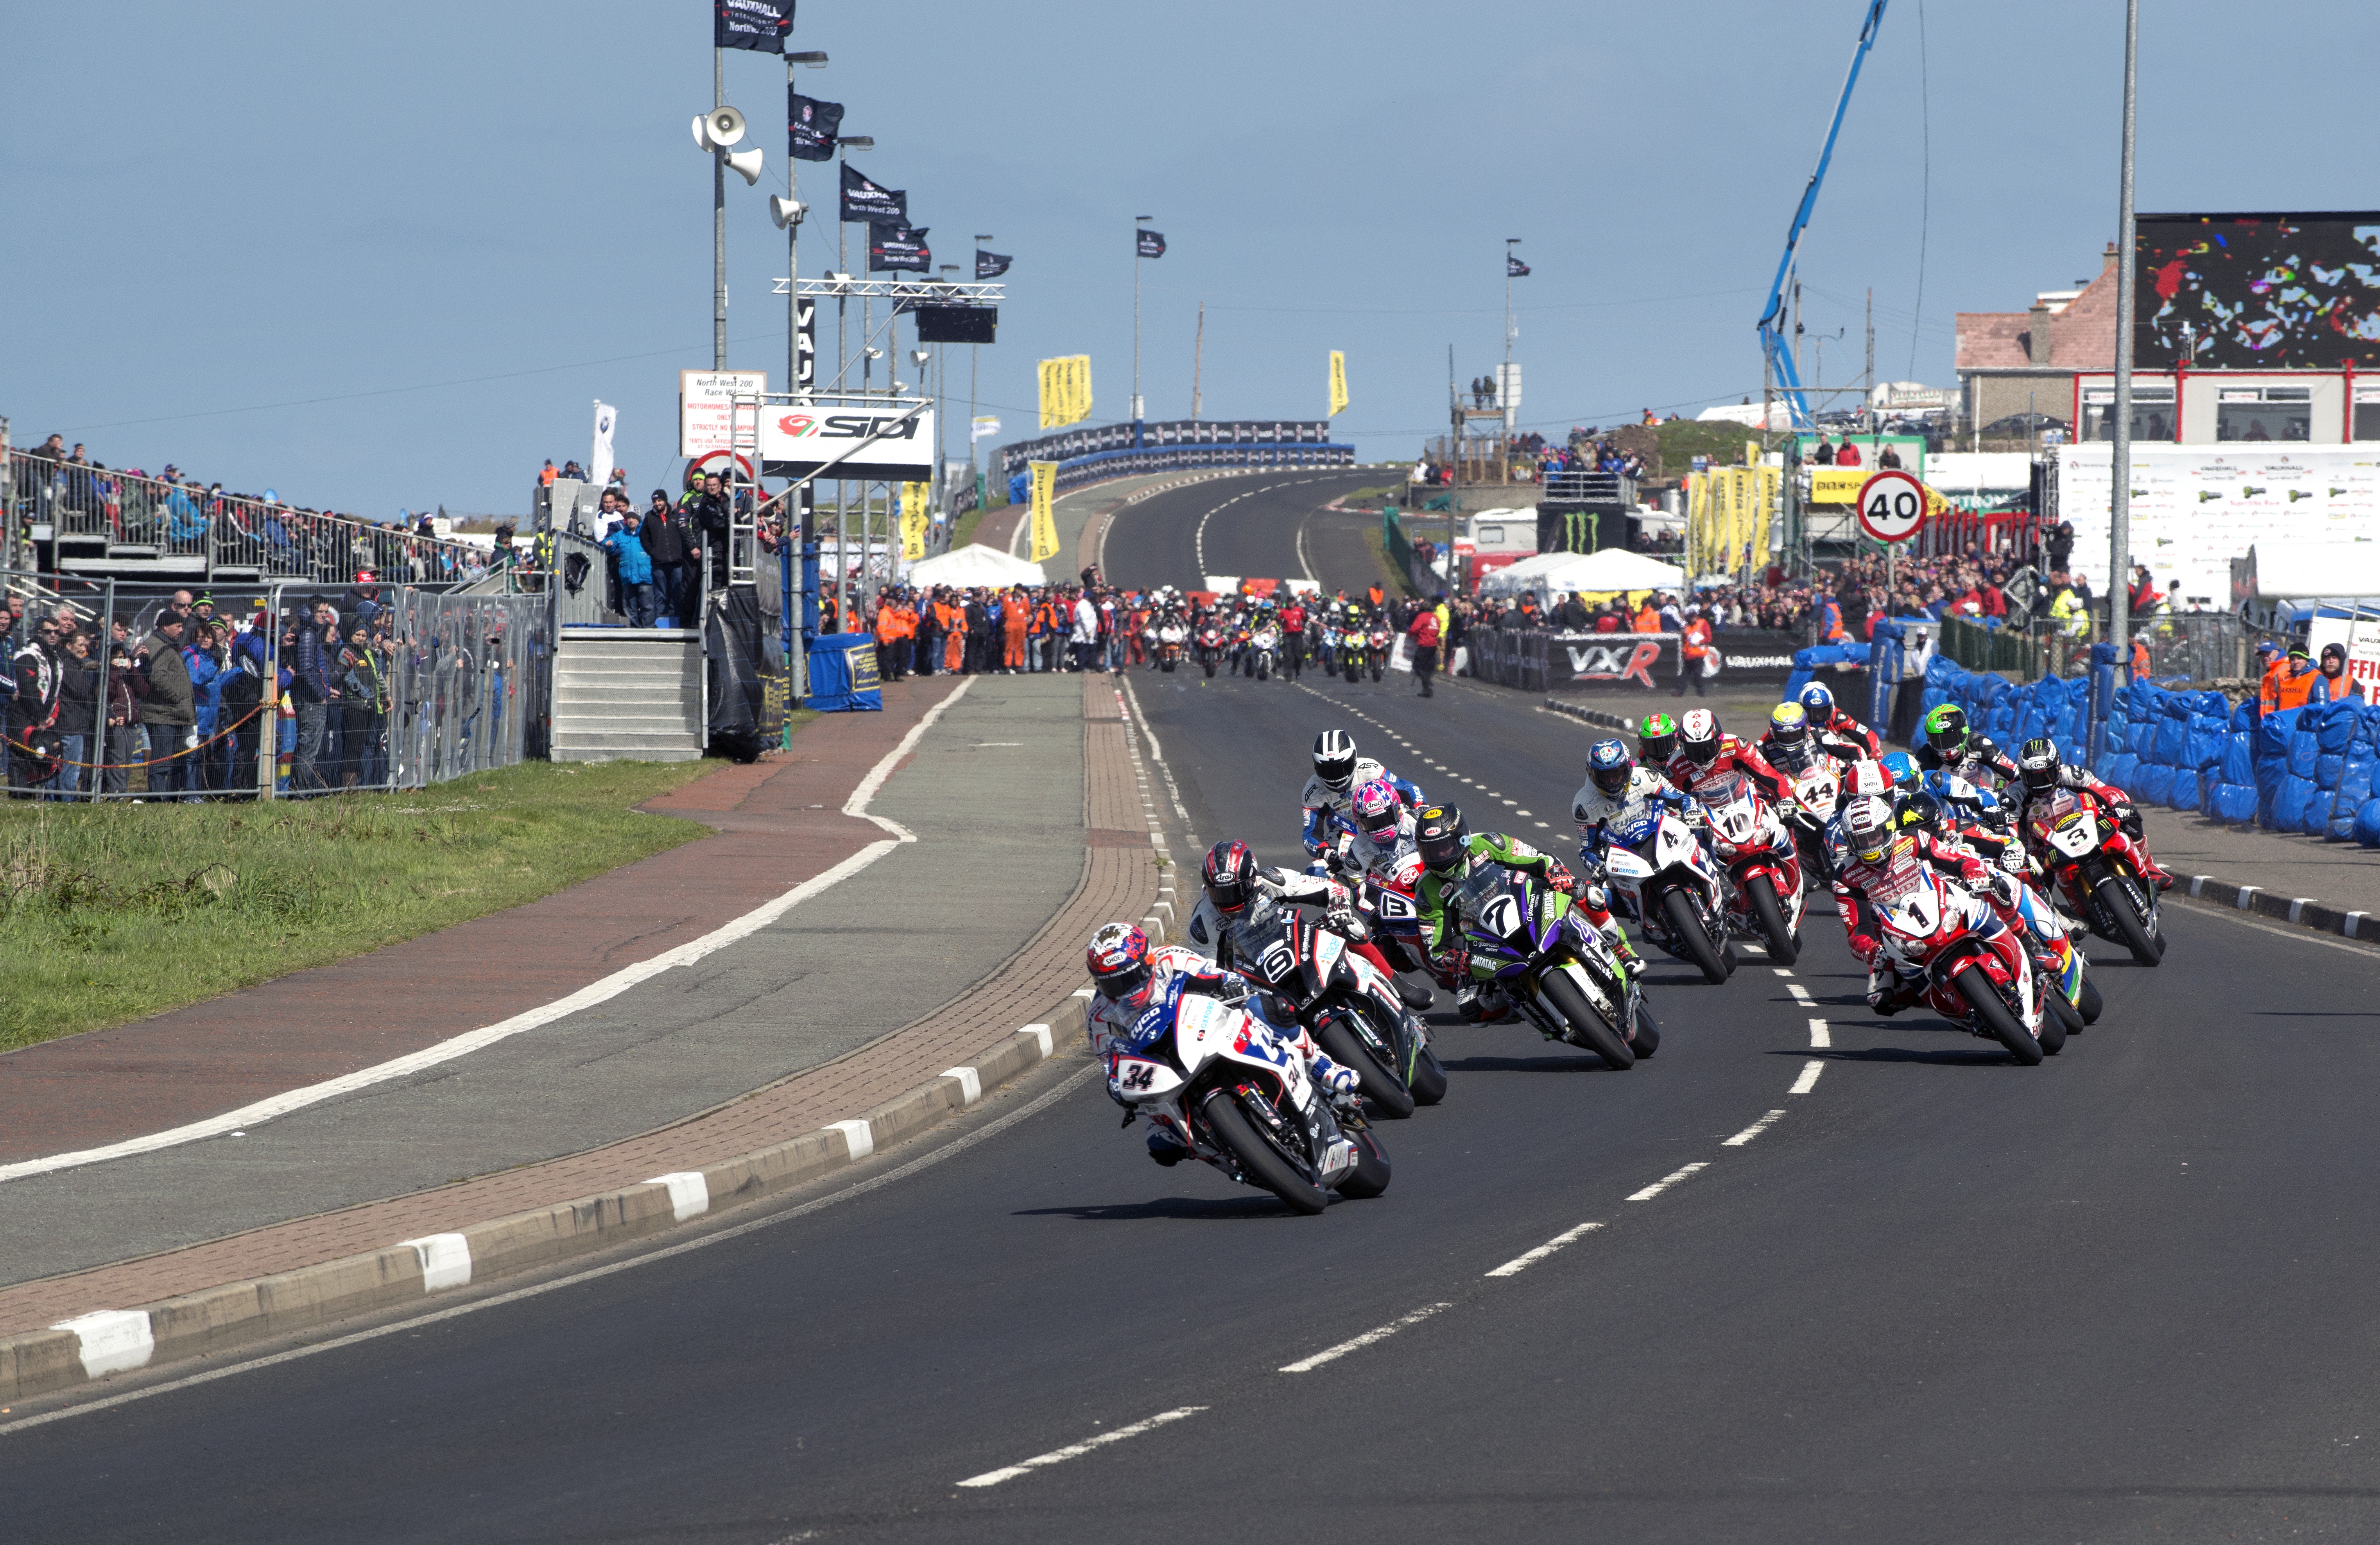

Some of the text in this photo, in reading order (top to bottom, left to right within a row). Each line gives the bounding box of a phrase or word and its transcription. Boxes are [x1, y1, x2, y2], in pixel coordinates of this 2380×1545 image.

[847, 188, 890, 199] VAUXHA
[867, 204, 886, 213] West
[886, 206, 900, 215] 200
[1867, 491, 1918, 520] 40
[1566, 641, 1661, 687] VXR
[1725, 655, 1794, 668] VAUXHAL
[1676, 760, 1689, 769] MOTUL
[1713, 770, 1735, 780] Racing
[1804, 782, 1833, 805] 44
[1624, 820, 1647, 836] tyco
[1722, 812, 1752, 838] 10
[2055, 812, 2082, 830] DUNLOP
[1401, 840, 1413, 849] Arai
[1662, 830, 1678, 850] 4
[1897, 839, 1912, 851] DUNLOP
[2067, 828, 2088, 847] 3
[1303, 839, 1318, 852] tyco
[1858, 846, 1883, 854] DENNISON
[1894, 857, 1912, 871] HITACHI
[1215, 873, 1233, 882] Arai
[1846, 866, 1866, 879] MOTUL
[1862, 878, 1878, 889] SHOEI
[1868, 867, 1919, 898] Honda Racing
[2096, 876, 2112, 887] YAMAHA
[1440, 884, 1452, 898] BELL
[1482, 897, 1512, 937] 7
[1907, 902, 1930, 929] 1
[1216, 920, 1231, 931] Arai
[1319, 935, 1340, 961] hager
[1106, 954, 1124, 964] SHOEI
[1264, 948, 1295, 984] 9
[1582, 943, 1613, 980] Kawasaki
[1201, 1001, 1215, 1029] OXFORD
[1130, 1007, 1161, 1039] tyco
[1122, 1063, 1158, 1092] 34
